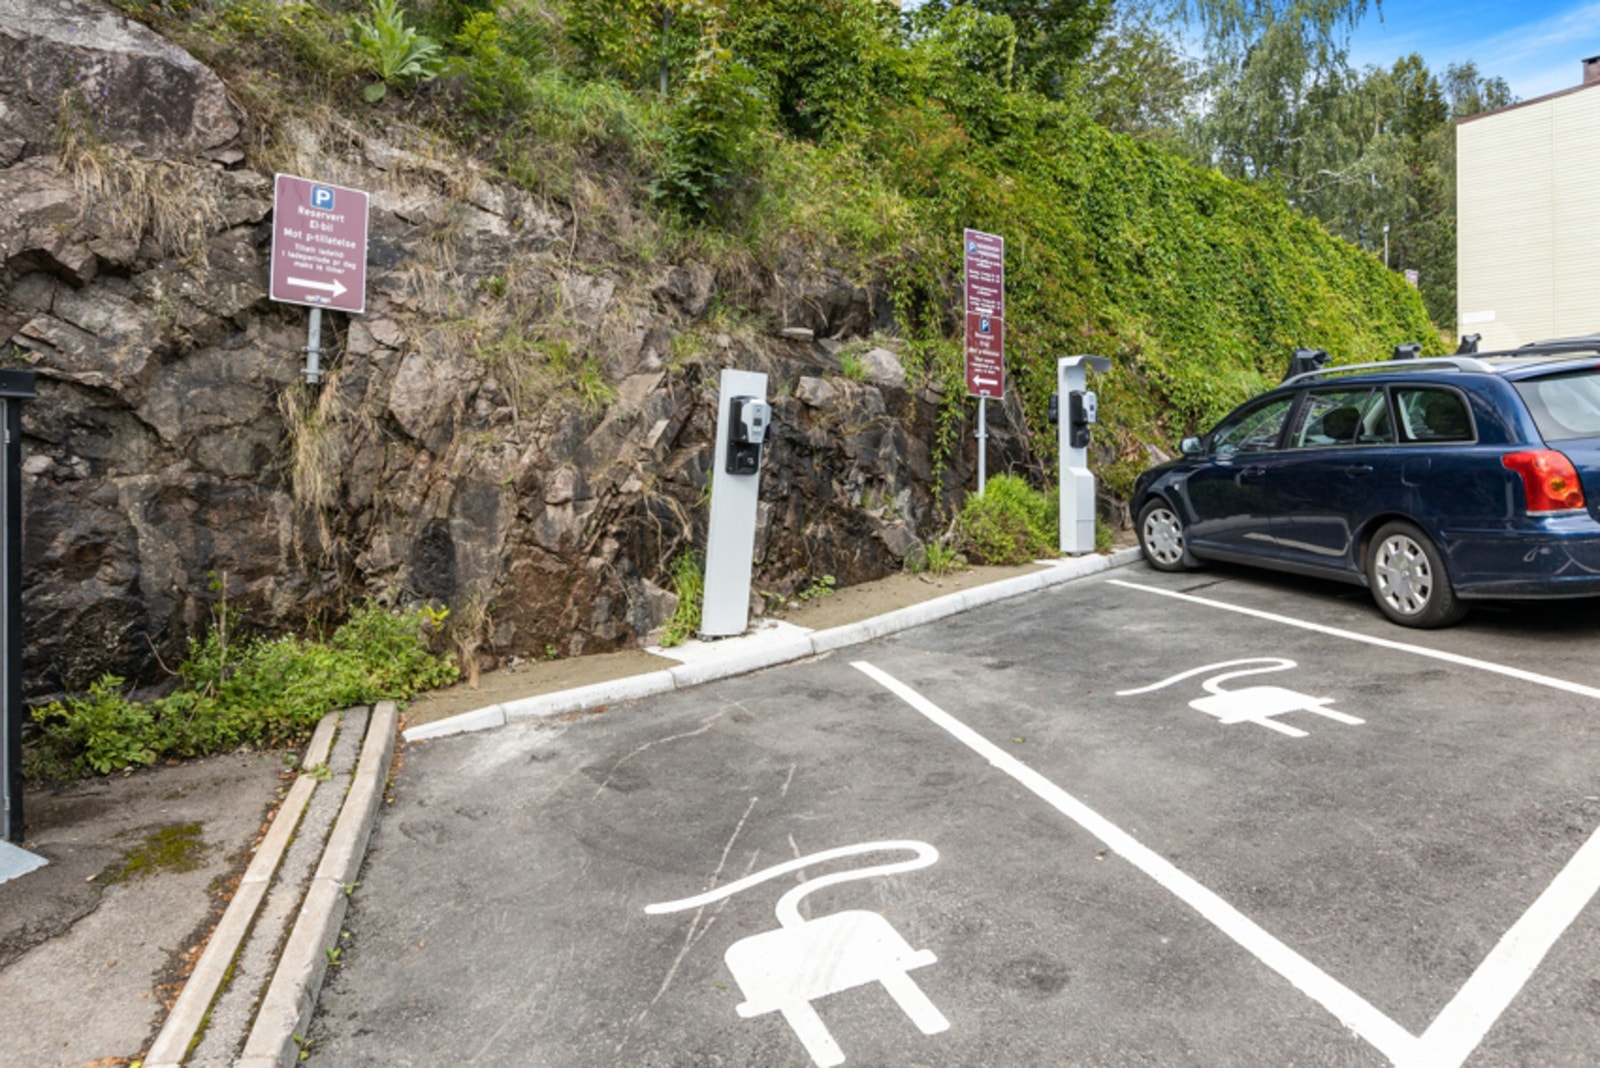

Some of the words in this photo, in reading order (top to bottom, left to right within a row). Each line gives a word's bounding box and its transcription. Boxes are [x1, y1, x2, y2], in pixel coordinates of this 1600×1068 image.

[316, 189, 330, 205] P
[298, 206, 345, 223] Reservert
[310, 220, 334, 232] El-bil
[283, 227, 302, 239] Mot
[306, 233, 356, 249] p-tillatelse
